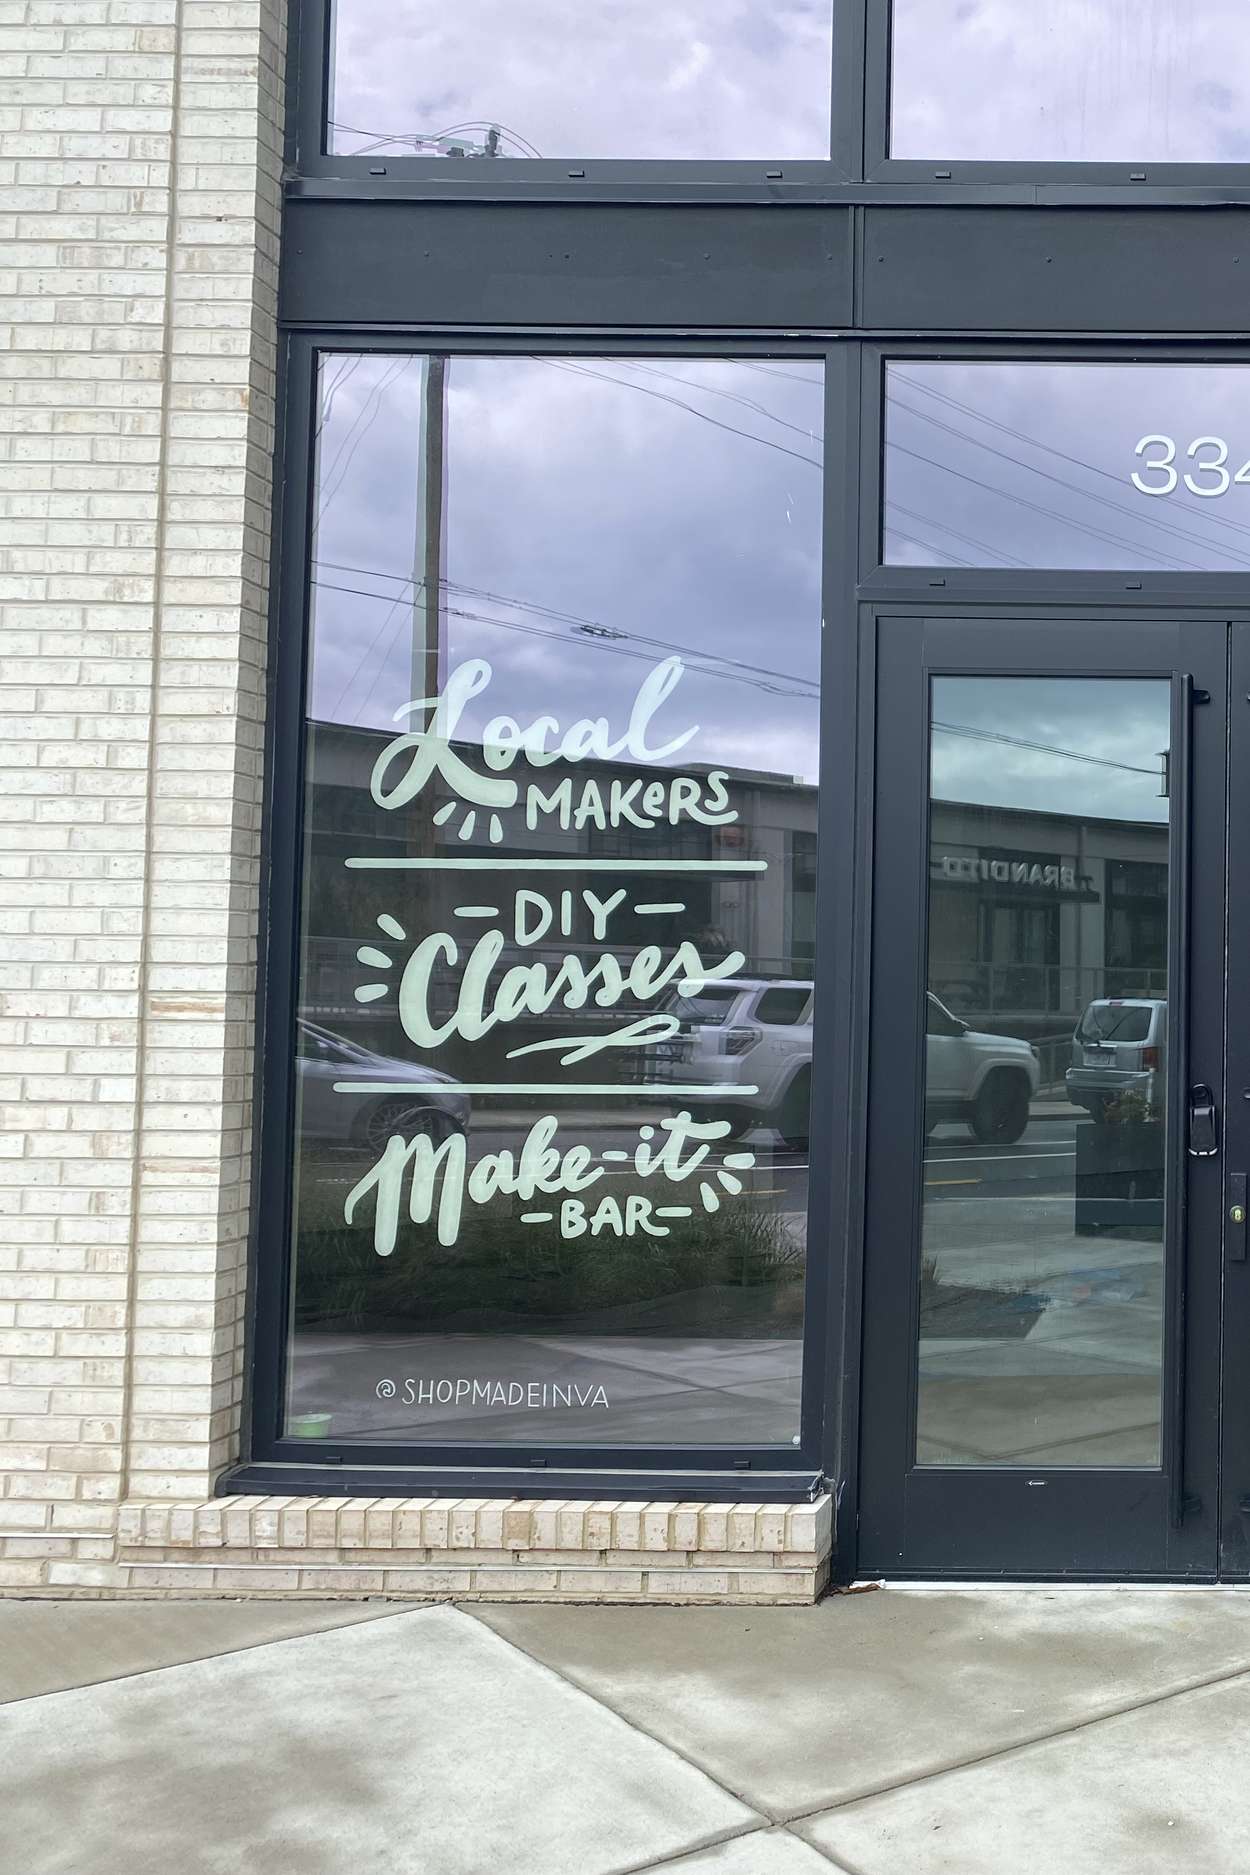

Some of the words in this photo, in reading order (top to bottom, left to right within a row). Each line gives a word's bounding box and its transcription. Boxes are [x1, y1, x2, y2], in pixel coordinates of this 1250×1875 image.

[370, 656, 699, 810] Local
[514, 888, 627, 945] DIY
[399, 930, 745, 1048] Classes
[560, 1196, 670, 1238] BAR
